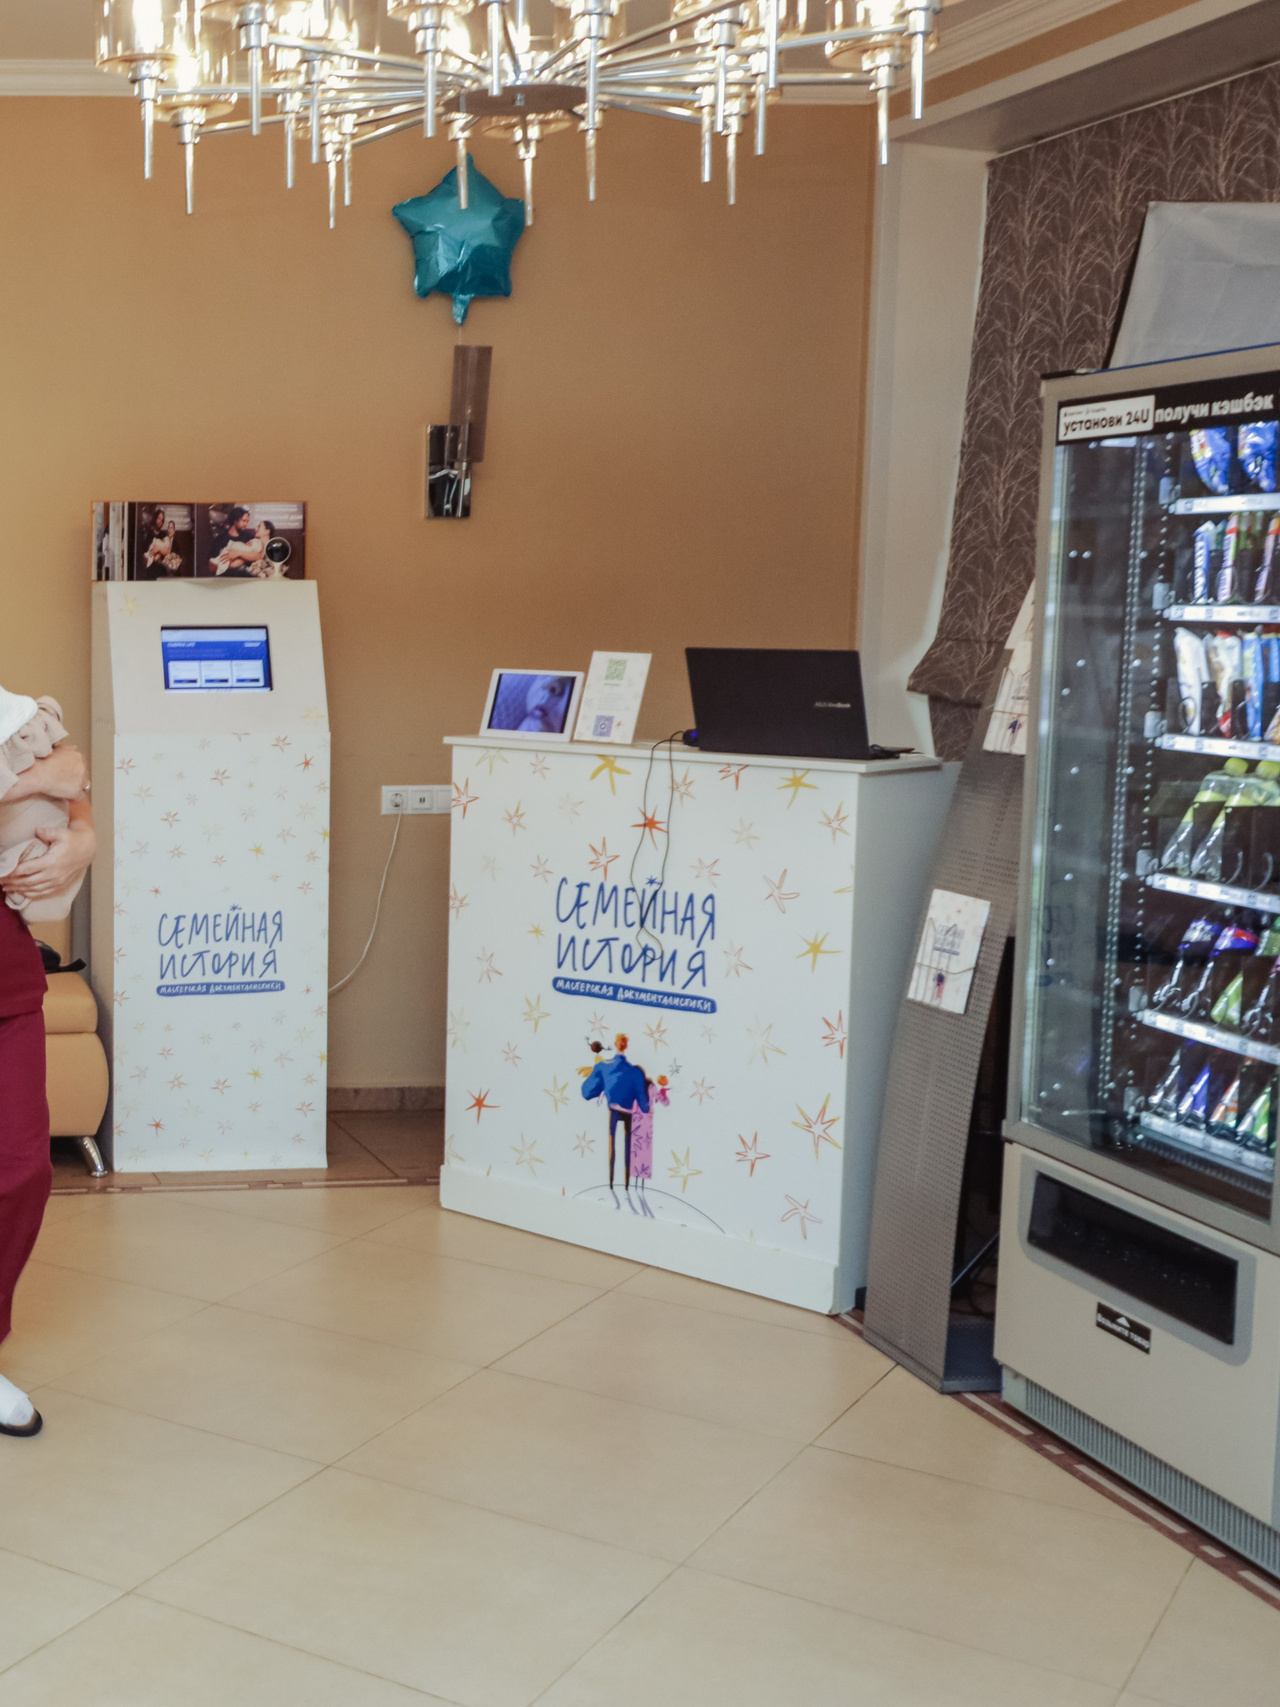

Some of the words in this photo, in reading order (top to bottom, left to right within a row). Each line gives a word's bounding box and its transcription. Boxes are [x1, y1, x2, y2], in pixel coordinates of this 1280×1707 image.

[1064, 415, 1122, 437] установи
[1126, 408, 1150, 426] 24U
[1154, 402, 1210, 424] получи
[1211, 391, 1274, 416] кэшбэк
[158, 904, 283, 949] СЕМЕЙНАЯ
[556, 876, 715, 948] СЕМЕЙНАЯ
[160, 949, 277, 980] ИСТОРИЯ
[557, 933, 706, 990] ИСТОРИЯ
[159, 984, 207, 994] МАСТЕРСКАЯ
[209, 982, 281, 994] ДОКУМЕНТАЛИСТИКИ
[556, 979, 613, 996] МАСТЕРСКАЯ
[616, 987, 711, 1012] ДОКУМЕНТАЛИСТИКИ
